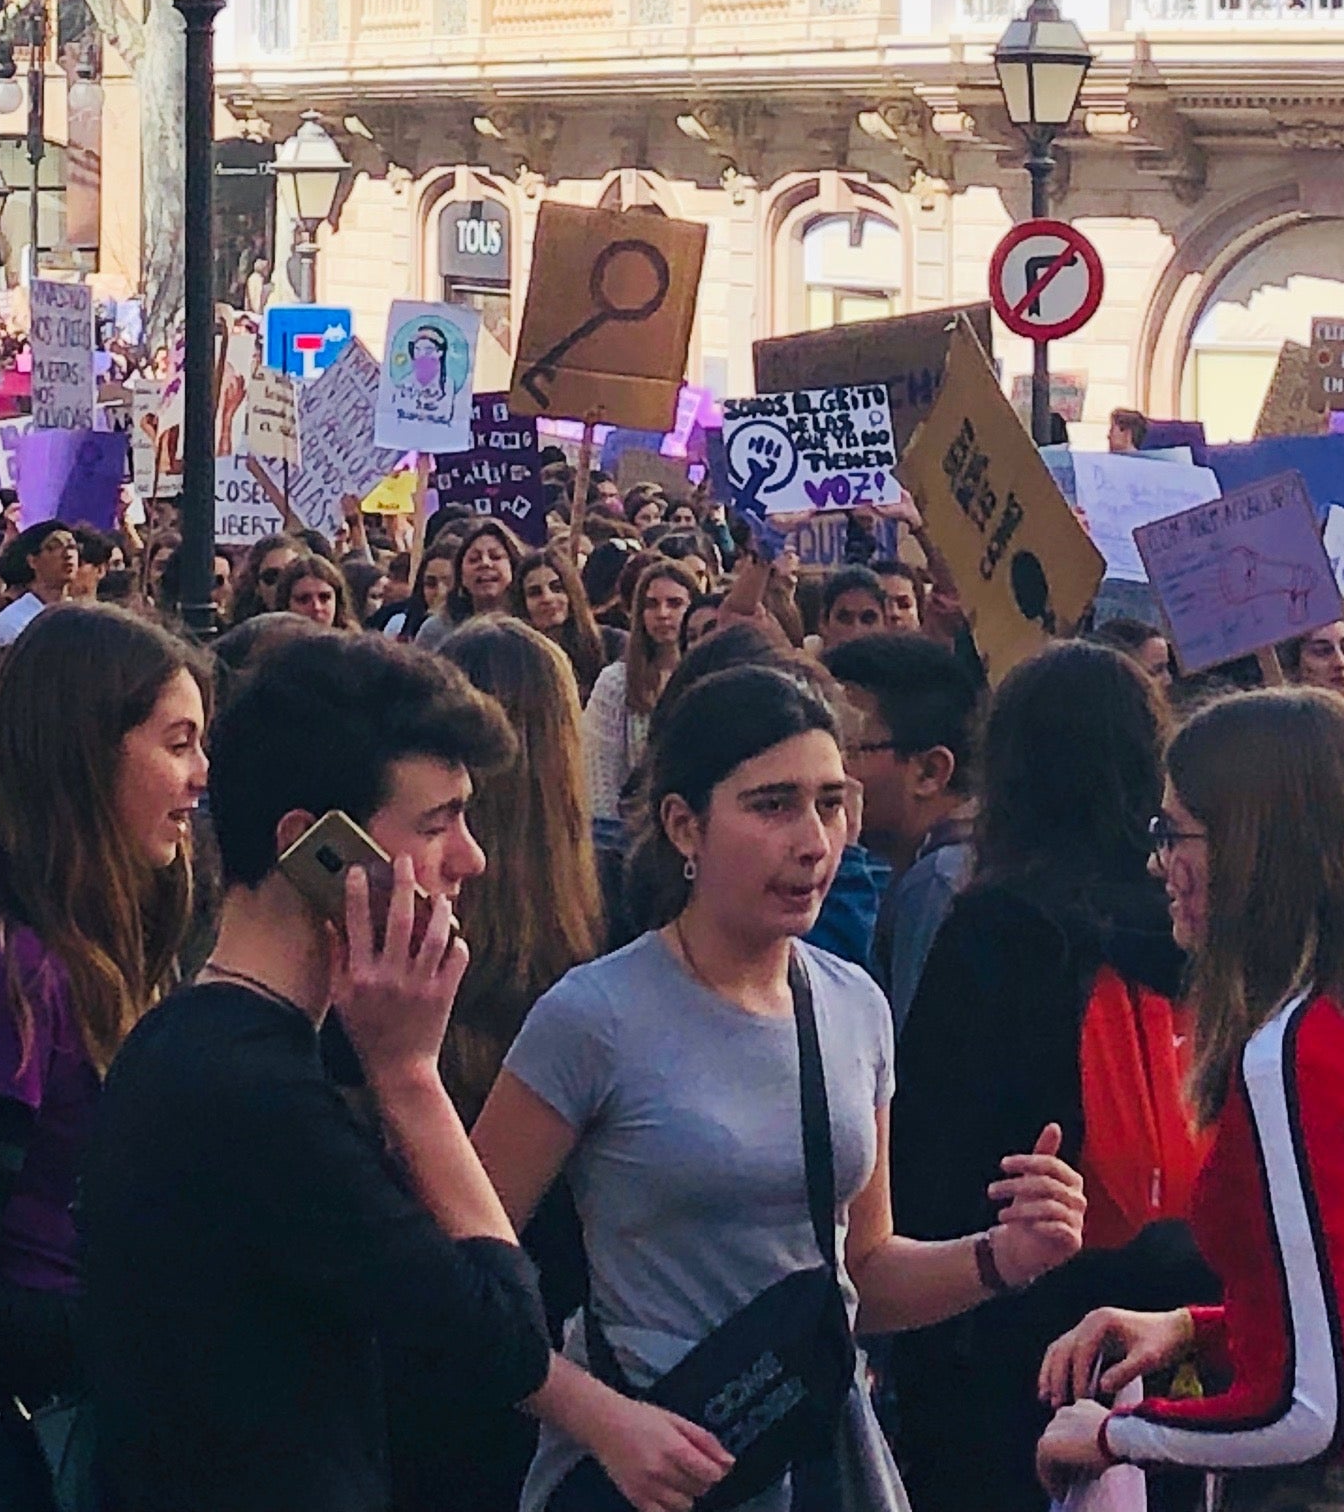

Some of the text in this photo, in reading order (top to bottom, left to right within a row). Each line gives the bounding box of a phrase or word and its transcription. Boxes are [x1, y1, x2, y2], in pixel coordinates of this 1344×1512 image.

[456, 219, 501, 256] TOUS
[724, 394, 789, 421] SOMOS
[818, 386, 886, 412] GRITO
[786, 413, 854, 438] DE LAS
[803, 471, 887, 508] VOZ!
